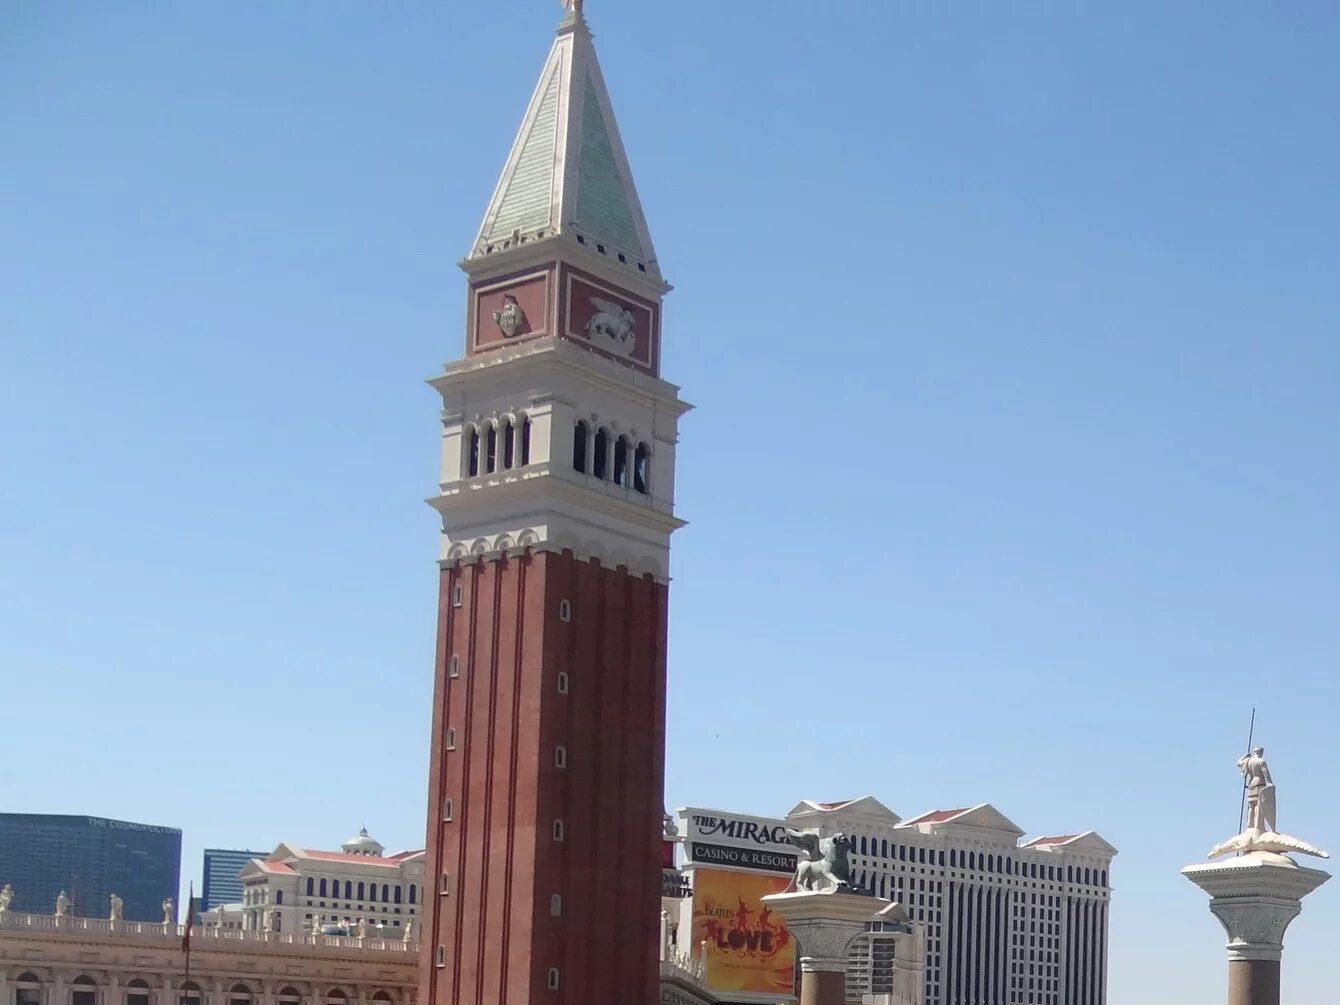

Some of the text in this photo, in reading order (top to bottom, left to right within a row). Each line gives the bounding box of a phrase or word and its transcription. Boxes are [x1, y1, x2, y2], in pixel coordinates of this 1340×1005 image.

[87, 817, 107, 828] THE
[692, 815, 717, 828] THE
[695, 846, 796, 869] CASINO & RESORT
[716, 926, 773, 952] LOVE
